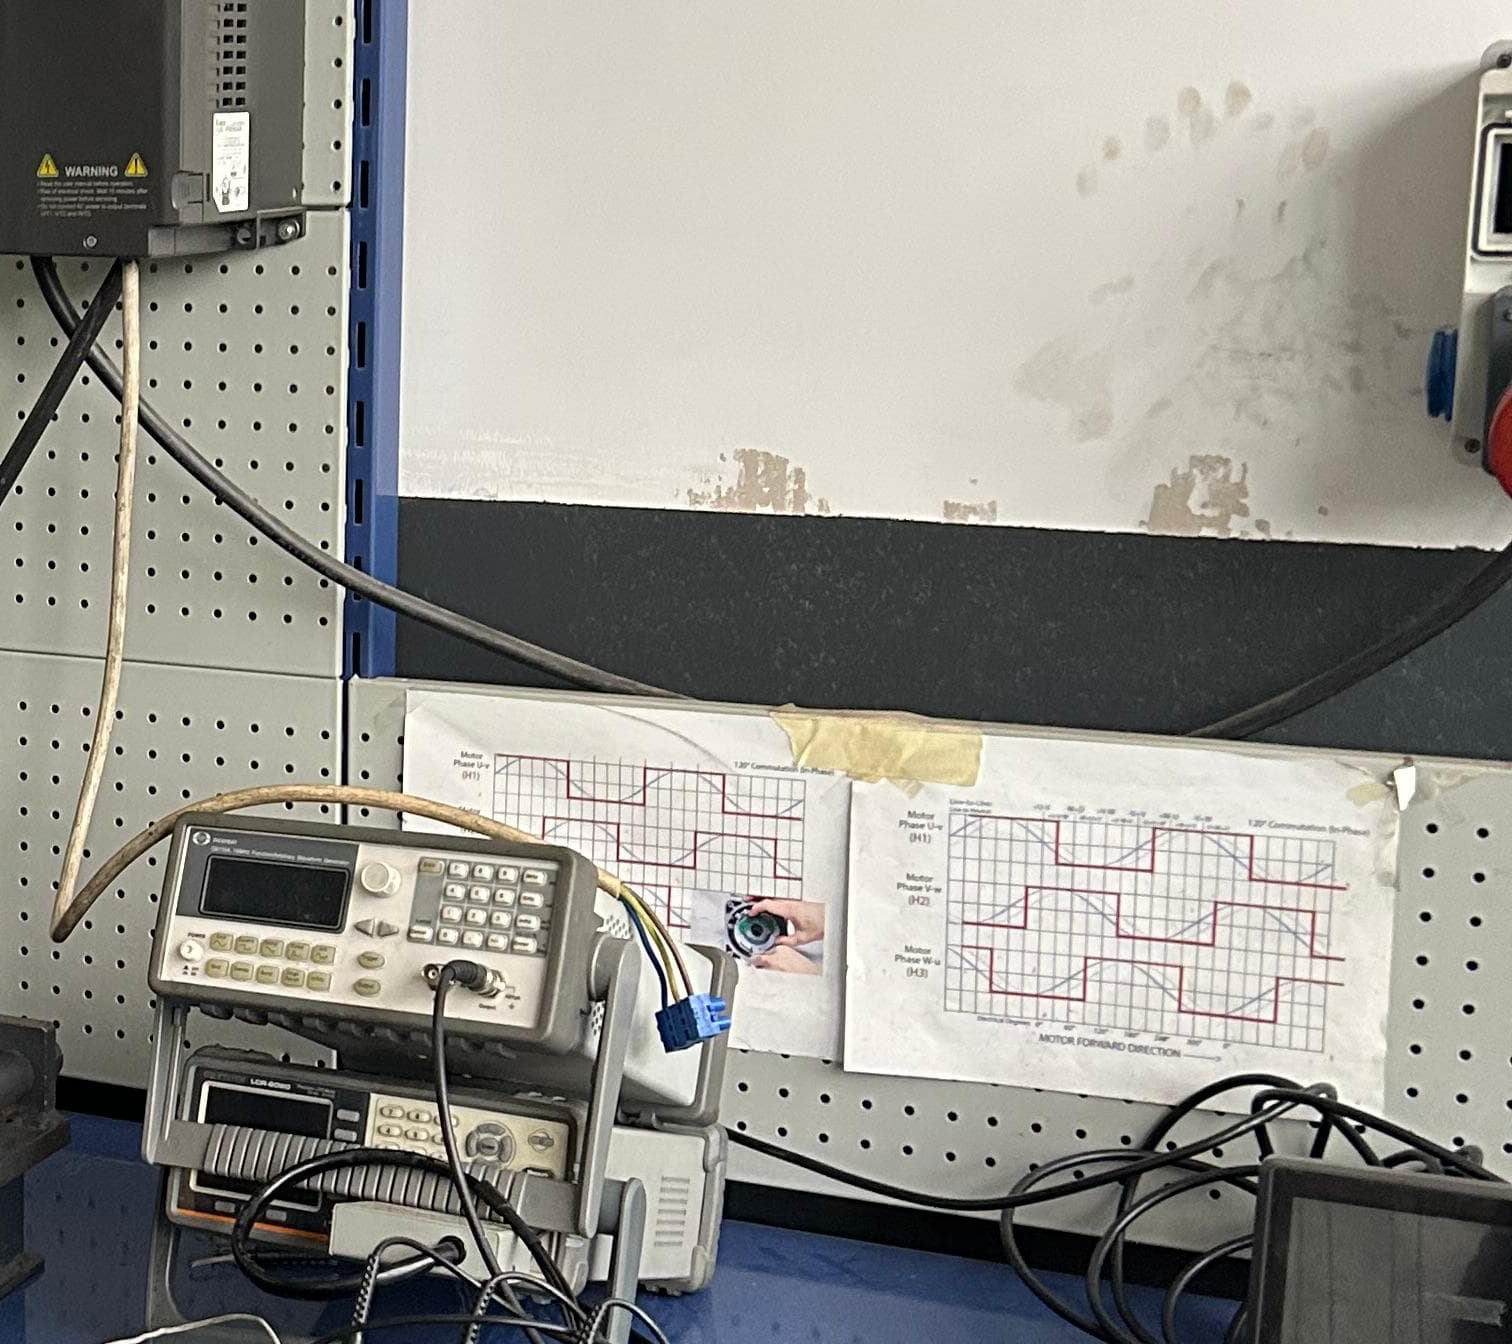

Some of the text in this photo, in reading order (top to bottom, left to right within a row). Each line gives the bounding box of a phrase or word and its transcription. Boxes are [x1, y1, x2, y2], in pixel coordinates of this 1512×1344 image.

[64, 165, 119, 178] WARNING
[460, 750, 483, 760] Motor
[453, 759, 477, 768] Phase
[461, 769, 481, 781] (H1)
[907, 809, 935, 821] Motor
[898, 818, 926, 831] Phase
[909, 832, 932, 845] (H1)
[906, 872, 934, 883] Motor
[896, 881, 924, 893] Phase
[908, 894, 931, 907] (H2)
[904, 944, 932, 956] Motor
[894, 954, 922, 966] Phase
[906, 967, 929, 979] (H3)
[1038, 1033, 1183, 1058] MOTOR FORWARD DIRECTION
